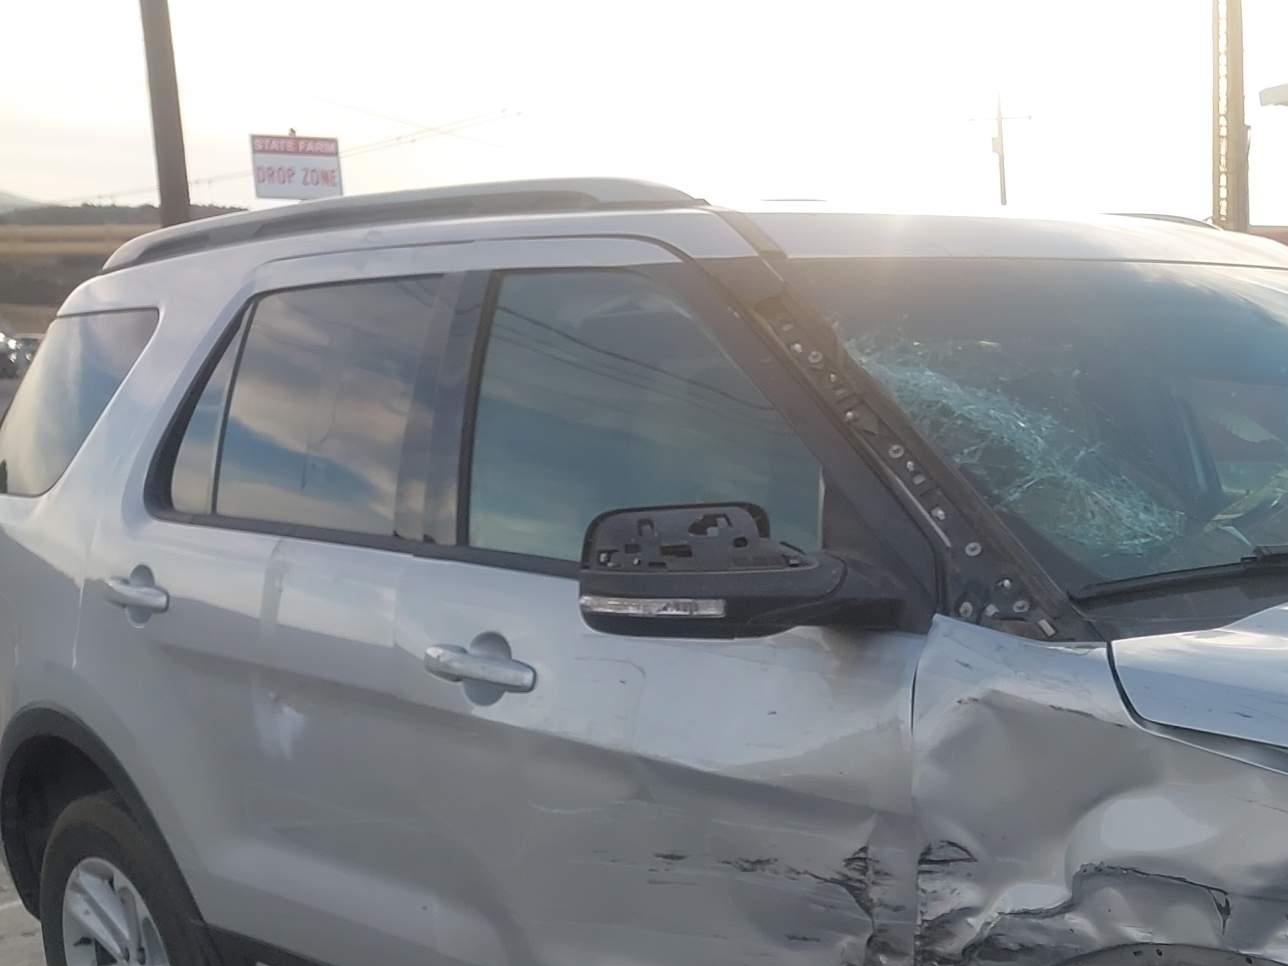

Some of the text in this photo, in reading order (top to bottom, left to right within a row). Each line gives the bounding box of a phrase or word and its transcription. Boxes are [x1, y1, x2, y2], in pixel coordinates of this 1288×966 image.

[255, 138, 336, 153] STATE FARM
[256, 166, 337, 187] DROP ZONE
